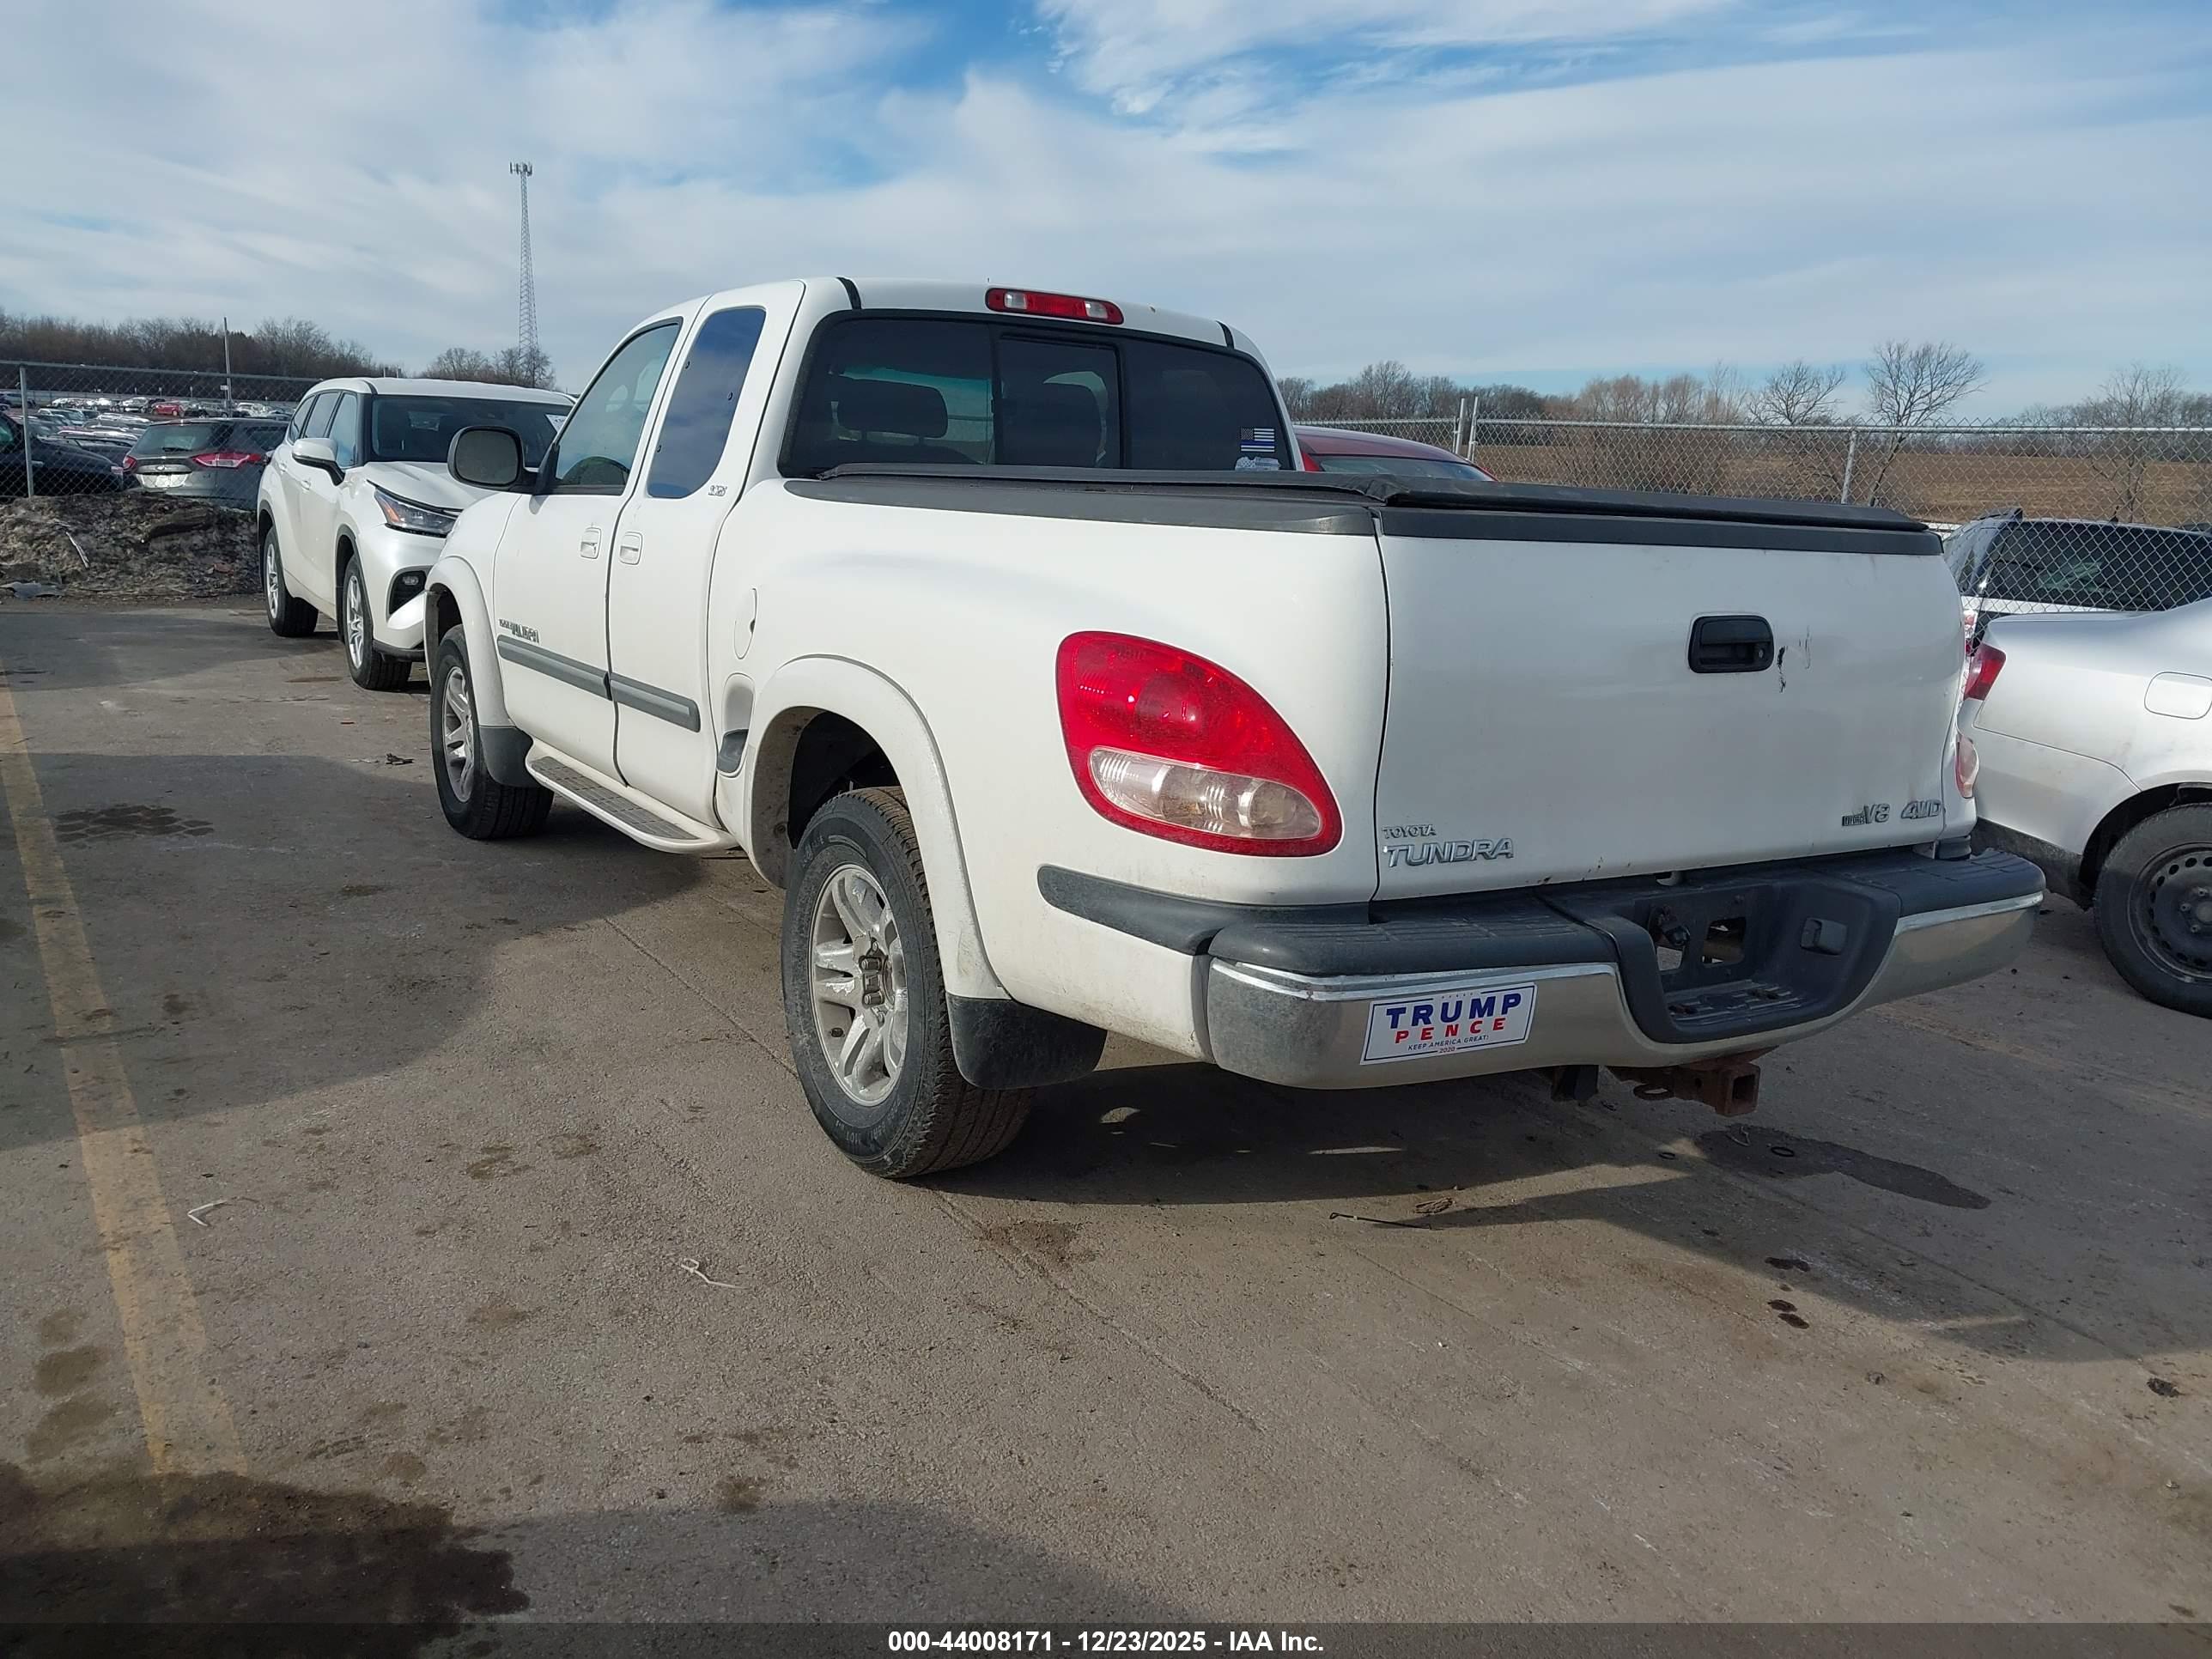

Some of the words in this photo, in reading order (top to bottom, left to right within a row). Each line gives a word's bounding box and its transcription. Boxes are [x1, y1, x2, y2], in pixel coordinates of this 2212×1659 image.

[1863, 804, 1890, 824] V8
[1900, 799, 1942, 819] 4WD
[1382, 824, 1437, 839] TOYOTA
[1382, 837, 1514, 868] TUNDRA
[1386, 993, 1522, 1030] TRUMP
[1395, 1018, 1506, 1044] PENCE
[1407, 1042, 1427, 1051] KEEP
[1428, 1038, 1462, 1048] AMERICA
[1463, 1035, 1490, 1043] GREAT!
